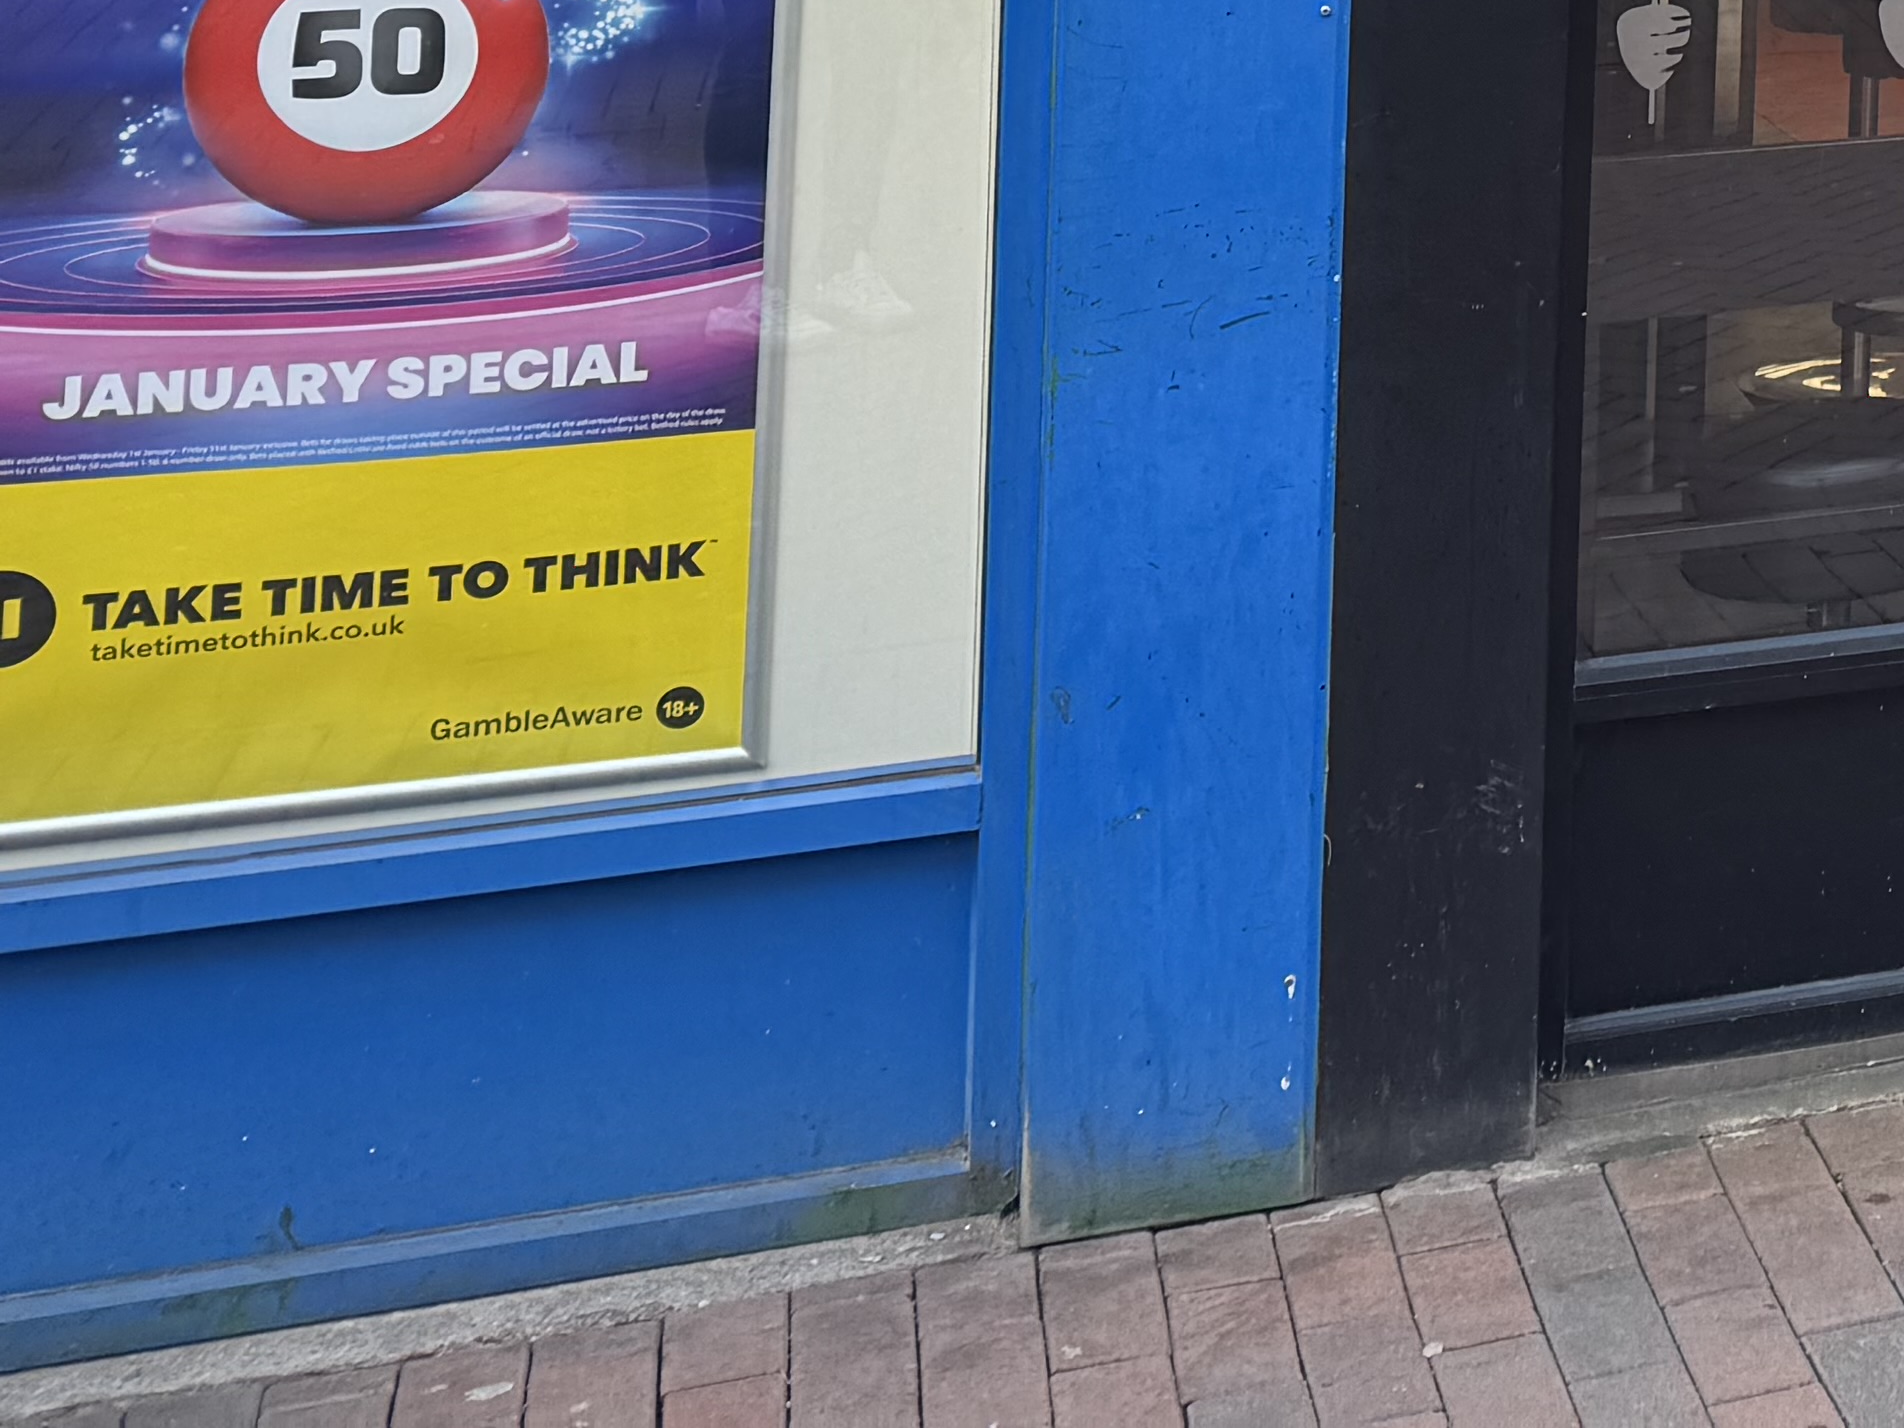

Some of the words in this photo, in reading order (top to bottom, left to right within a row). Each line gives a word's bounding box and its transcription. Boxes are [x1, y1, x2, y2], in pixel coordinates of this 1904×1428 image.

[291, 6, 447, 100] 50
[42, 358, 380, 421] JANUARY
[387, 341, 648, 402] SPECIAL
[82, 582, 242, 632] TAKE
[262, 569, 410, 617] TIME
[427, 560, 510, 601] TO
[90, 615, 405, 663] taketimetothink.co.uk
[430, 700, 644, 742] GambleAware
[661, 697, 700, 722] 18+
